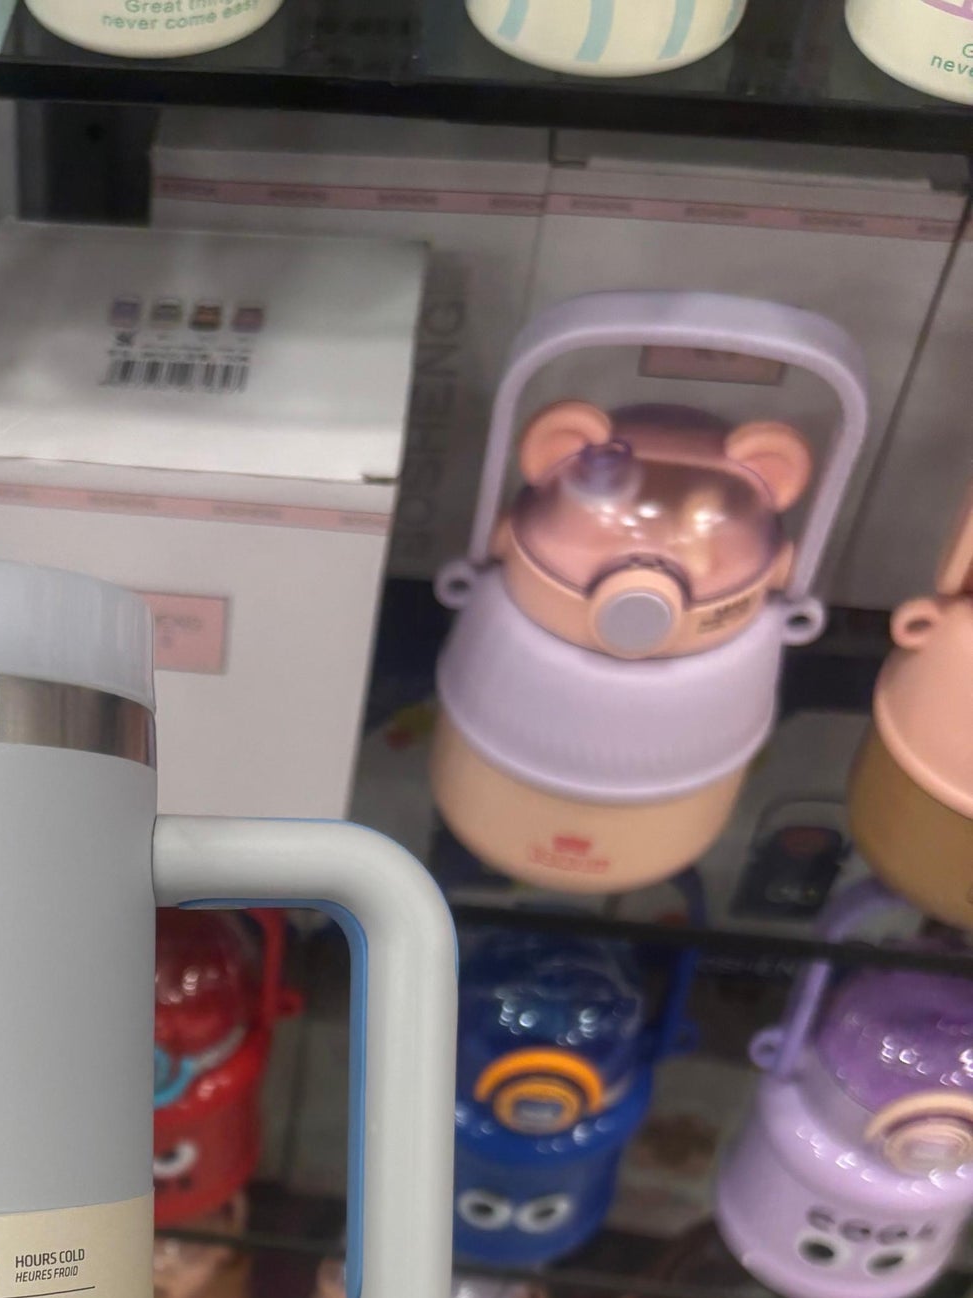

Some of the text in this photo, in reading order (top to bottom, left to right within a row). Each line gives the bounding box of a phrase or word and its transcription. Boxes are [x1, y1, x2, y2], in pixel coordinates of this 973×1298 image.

[101, 14, 158, 30] never
[165, 12, 217, 30] come
[15, 1248, 85, 1268] HOURS COLD
[15, 1265, 79, 1283] HEURES FROID
